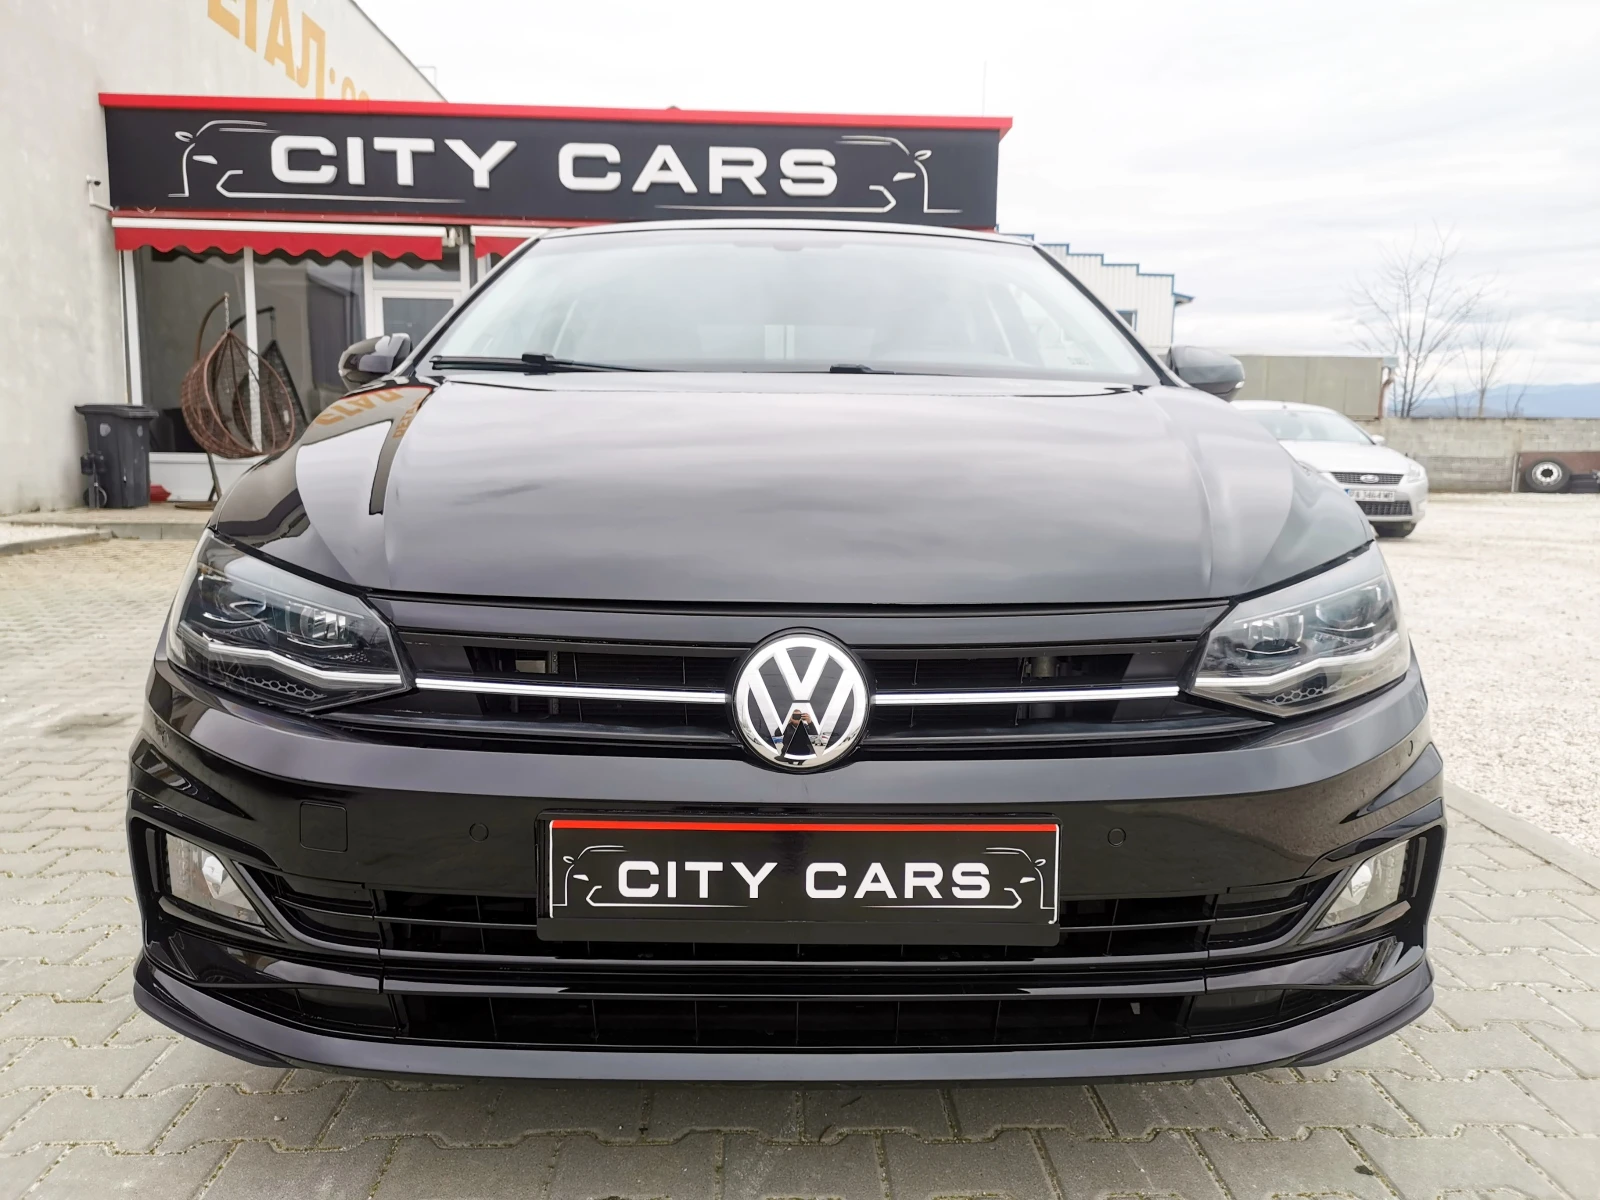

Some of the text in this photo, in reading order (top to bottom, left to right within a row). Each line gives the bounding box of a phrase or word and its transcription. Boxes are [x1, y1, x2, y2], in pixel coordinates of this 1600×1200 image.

[270, 135, 838, 196] CITY CARS
[618, 860, 991, 899] CITY CARS
